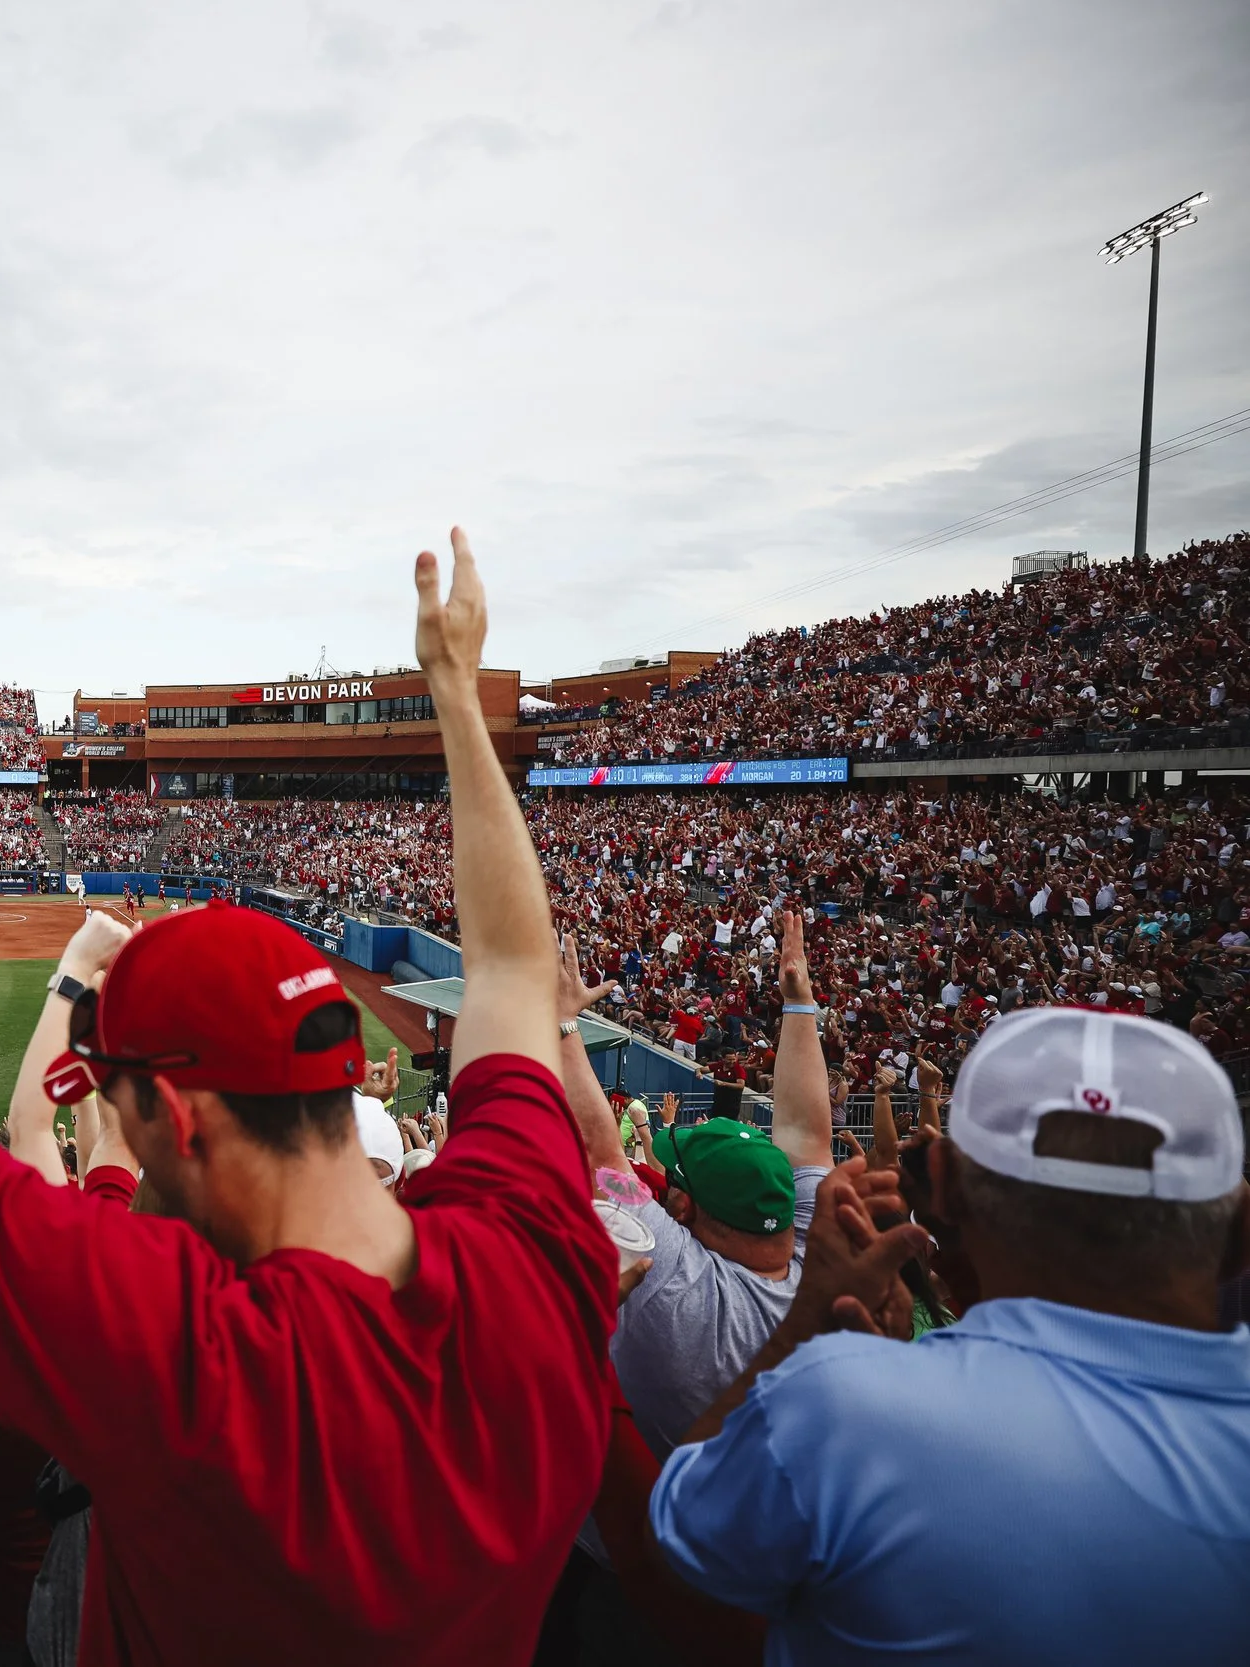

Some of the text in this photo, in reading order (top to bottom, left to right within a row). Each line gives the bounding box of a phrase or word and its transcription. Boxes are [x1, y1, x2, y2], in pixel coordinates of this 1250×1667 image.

[263, 680, 374, 702] DEVON PARK
[741, 762, 771, 771] PITCHING
[741, 771, 774, 781] MORGAN
[790, 770, 802, 780] 20
